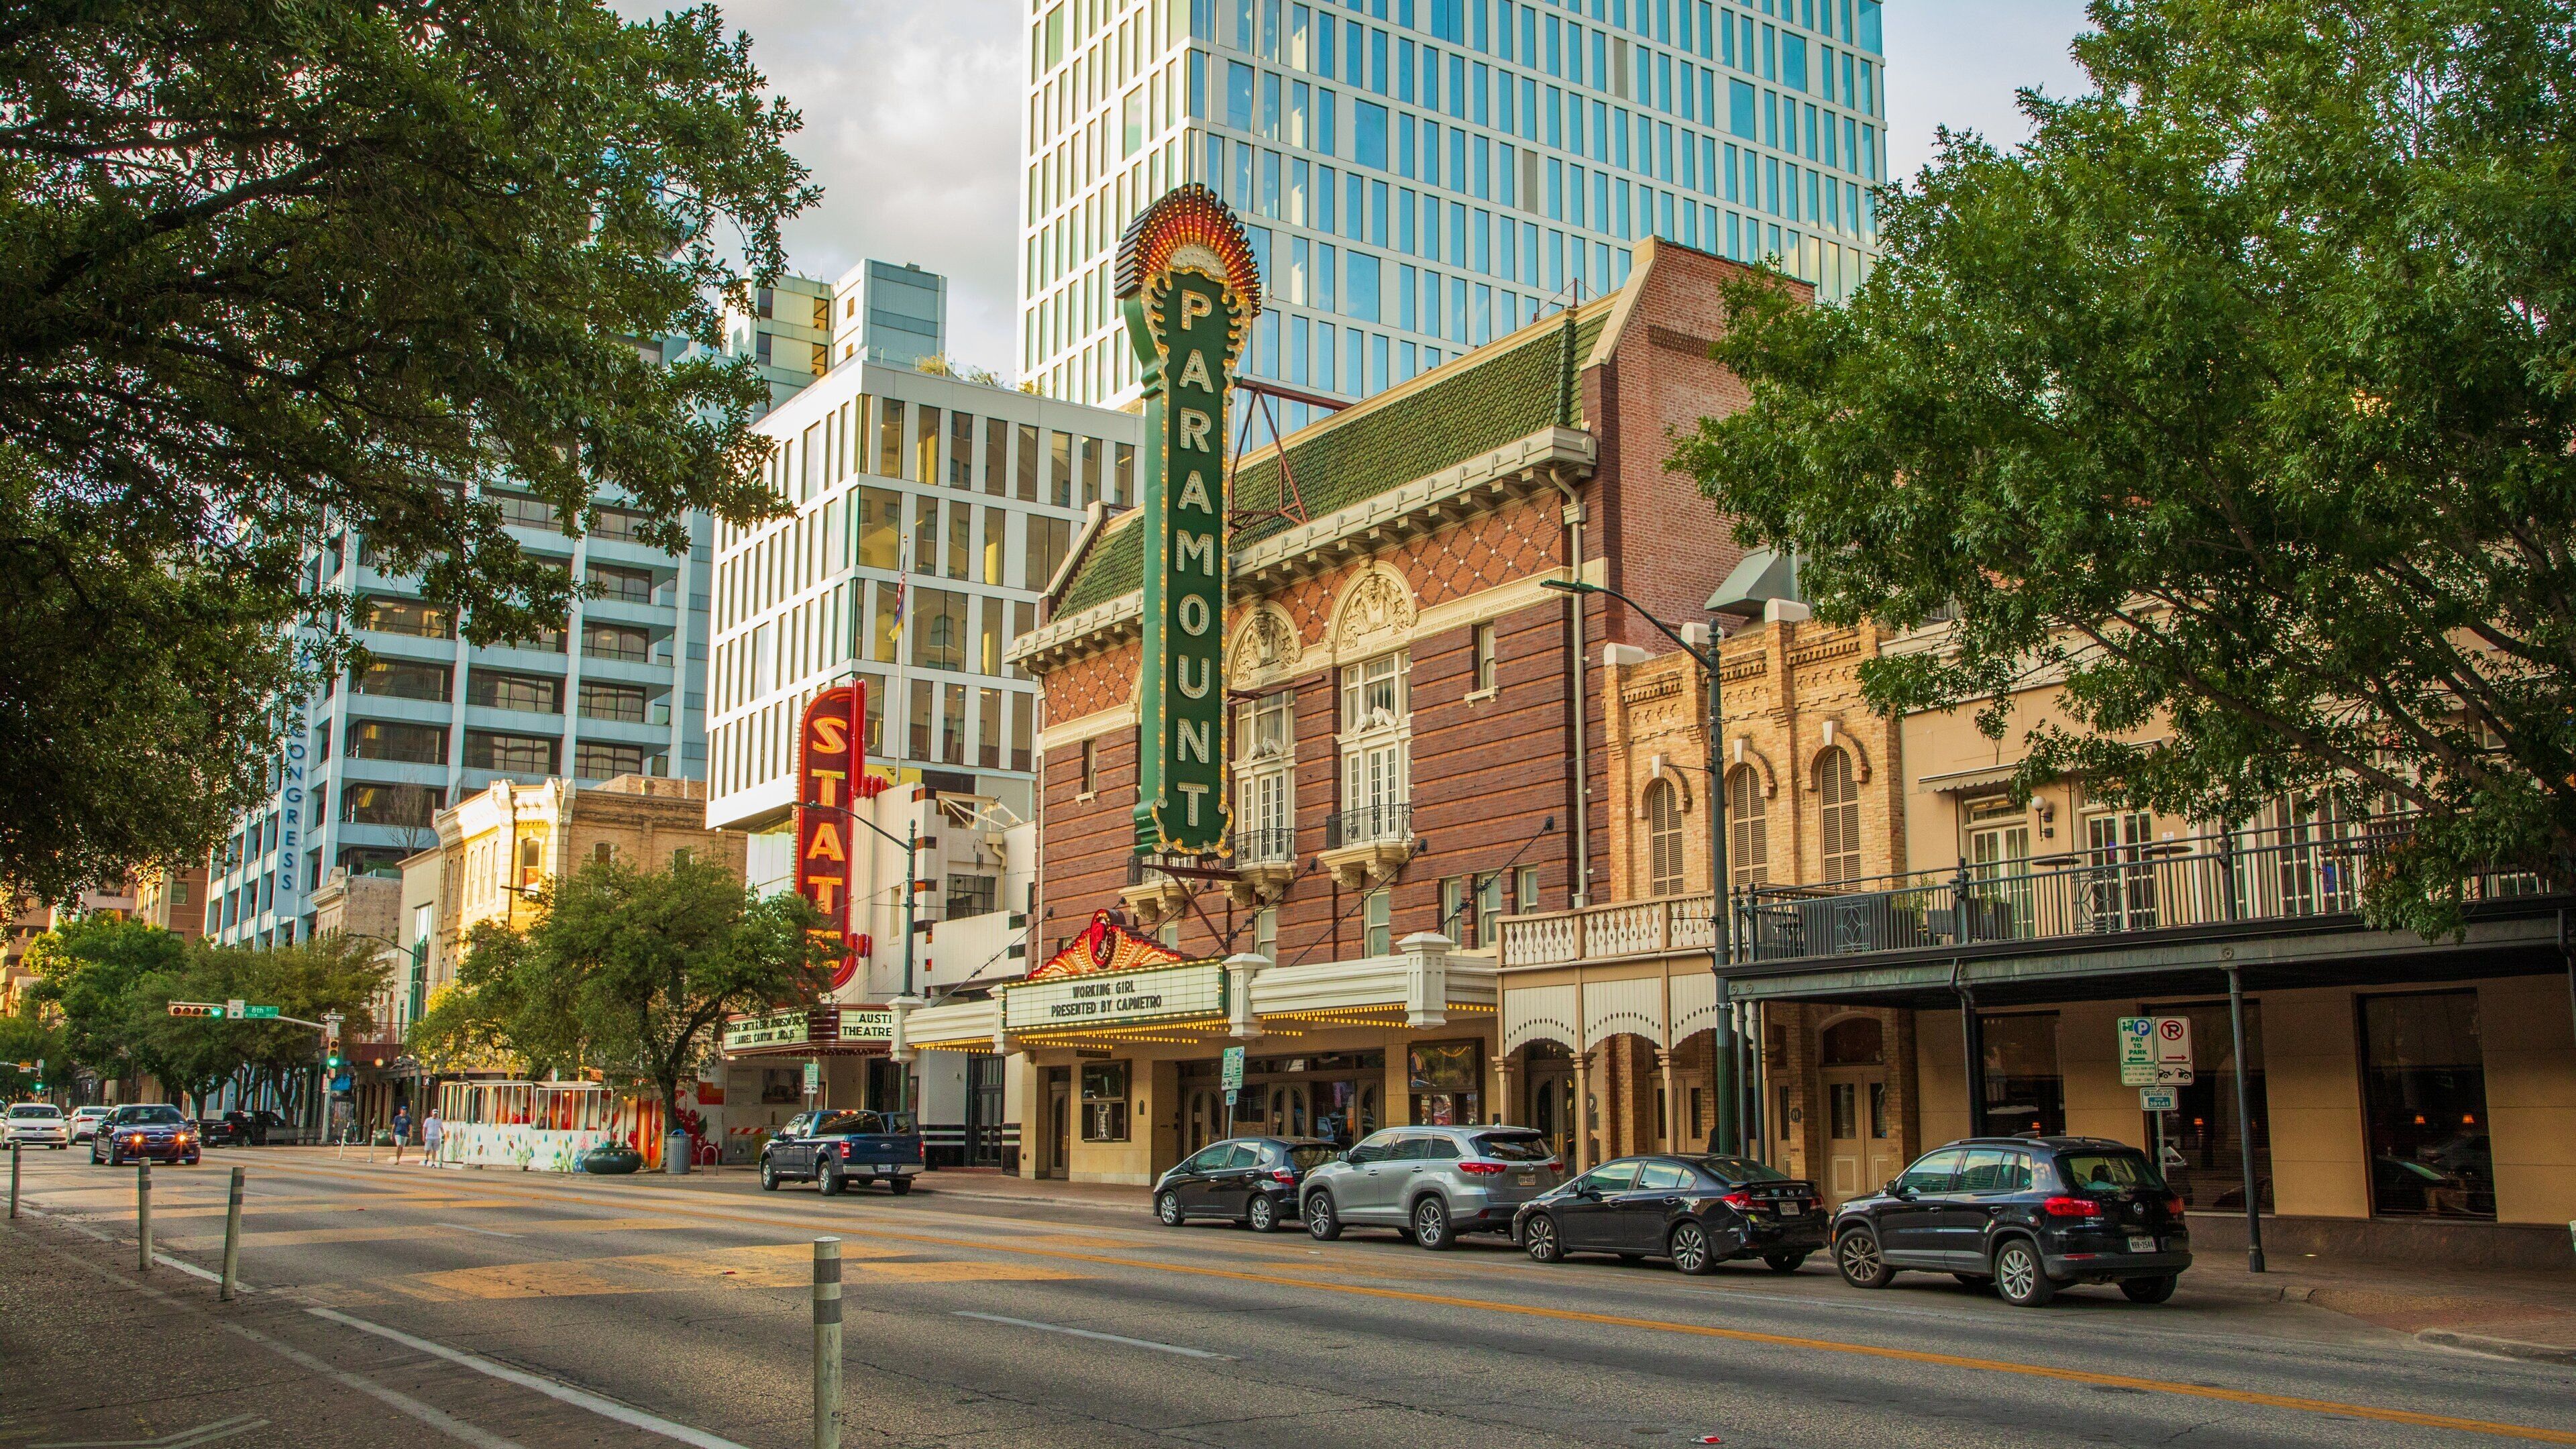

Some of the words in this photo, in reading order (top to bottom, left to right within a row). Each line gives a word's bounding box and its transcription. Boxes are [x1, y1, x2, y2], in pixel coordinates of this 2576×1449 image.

[1177, 288, 1214, 827] PARAMOUNT
[806, 716, 848, 969] STATE
[1072, 983, 1110, 999] WORKING
[1116, 979, 1135, 994] GIRL
[1051, 1001, 1096, 1017] PRESENTED
[1100, 999, 1112, 1013] BY
[1116, 994, 1162, 1012] CAPMETRO
[741, 1021, 755, 1032] SMITH
[858, 1014, 892, 1024] AUSTI
[735, 1034, 752, 1044] LAUREL
[754, 1032, 773, 1042] CANYON
[842, 1026, 892, 1036] THEATRE
